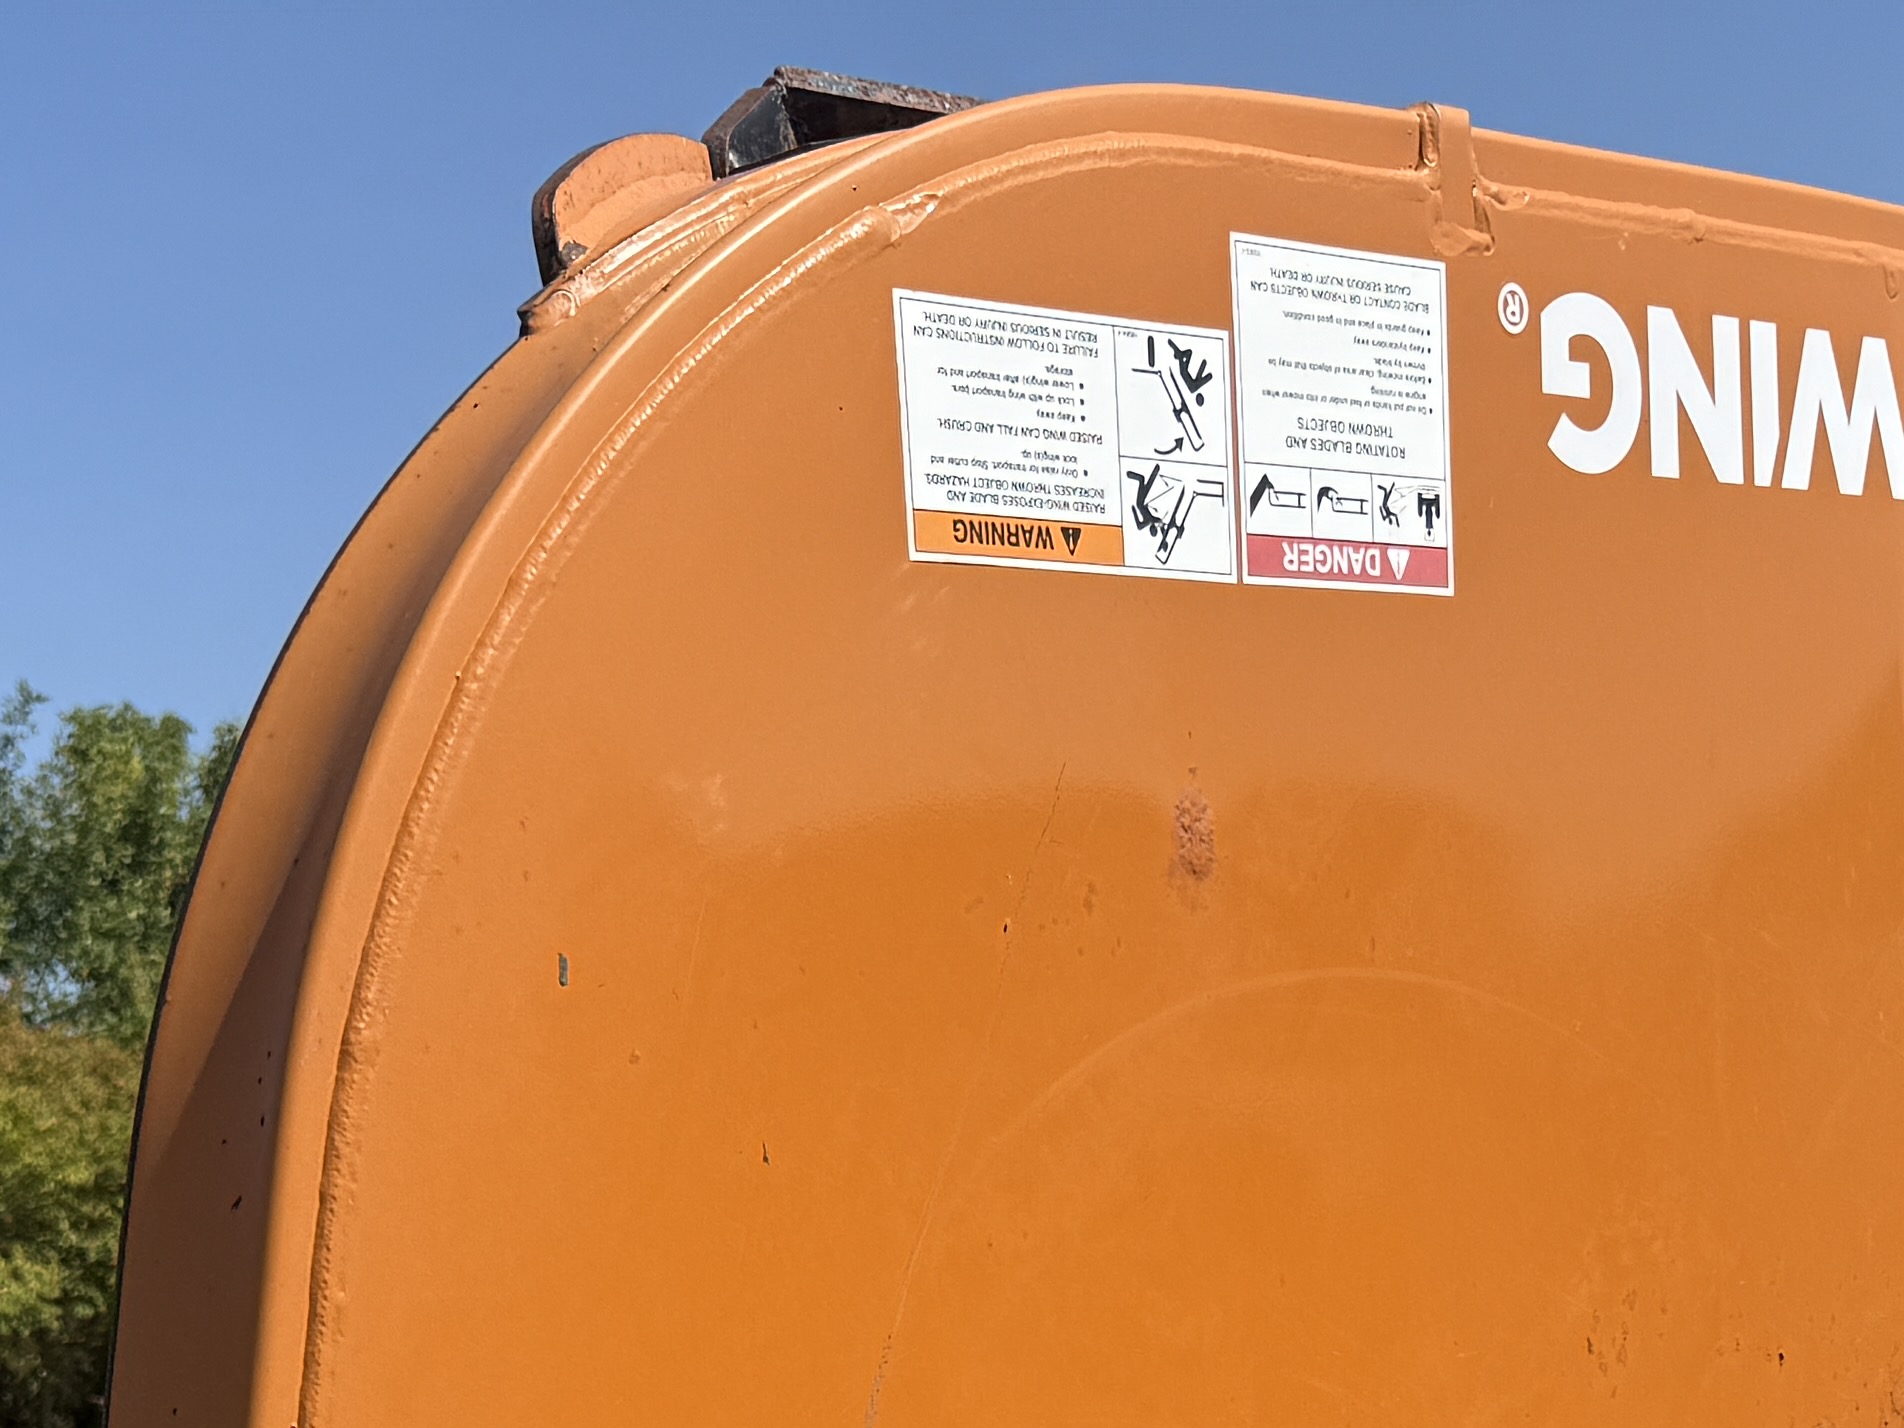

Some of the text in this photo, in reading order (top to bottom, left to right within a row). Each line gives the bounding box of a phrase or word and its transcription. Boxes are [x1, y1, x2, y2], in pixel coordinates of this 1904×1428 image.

[1301, 274, 1312, 284] OR
[1250, 281, 1429, 314] BLADE CONTACT OR THROWN OBJECTS CAN
[959, 317, 971, 328] OR
[1010, 323, 1049, 337] SERIOUS
[1052, 329, 1061, 338] IN
[1064, 330, 1097, 343] RESULT
[913, 325, 1098, 358] FAILURE TO FOLLOW INSTRUCTIONS CAN
[974, 422, 994, 433] AND
[997, 424, 1018, 435] FALL
[1021, 427, 1040, 437] CAN
[1297, 417, 1393, 438] THROWN OBJECTS
[1042, 429, 1066, 440] WING
[1069, 432, 1102, 445] RAISED
[1286, 436, 1405, 459] ROTATING BLADES AND
[972, 478, 1009, 490] OBJECT
[1011, 481, 1051, 494] THROWN
[947, 490, 966, 502] AND
[1054, 484, 1104, 499] INCREASES
[970, 493, 999, 505] BLADE
[1072, 501, 1105, 514] RAISED
[952, 518, 1054, 551] WARNING
[1281, 541, 1381, 577] DANGER
